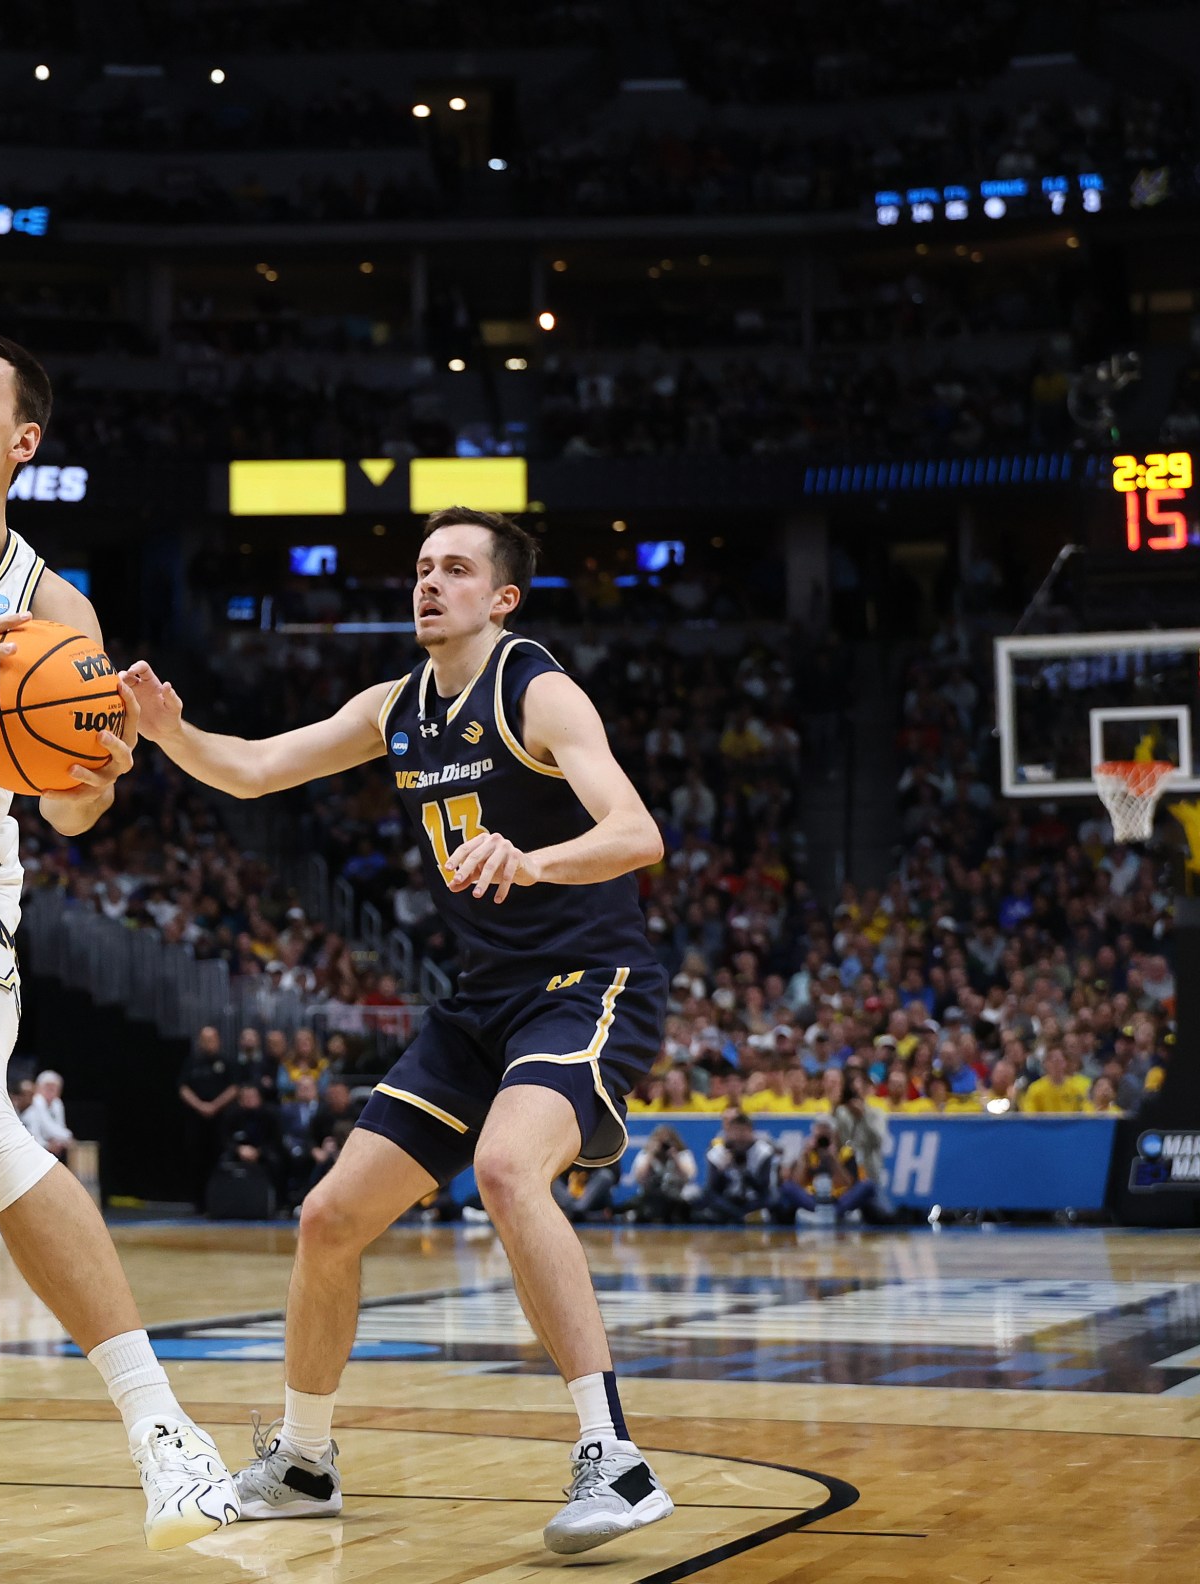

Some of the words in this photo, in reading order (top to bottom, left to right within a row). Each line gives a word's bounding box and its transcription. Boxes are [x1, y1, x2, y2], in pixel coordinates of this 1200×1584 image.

[1113, 452, 1192, 492] 2:29
[1125, 489, 1188, 551] 15
[439, 758, 494, 784] Diego
